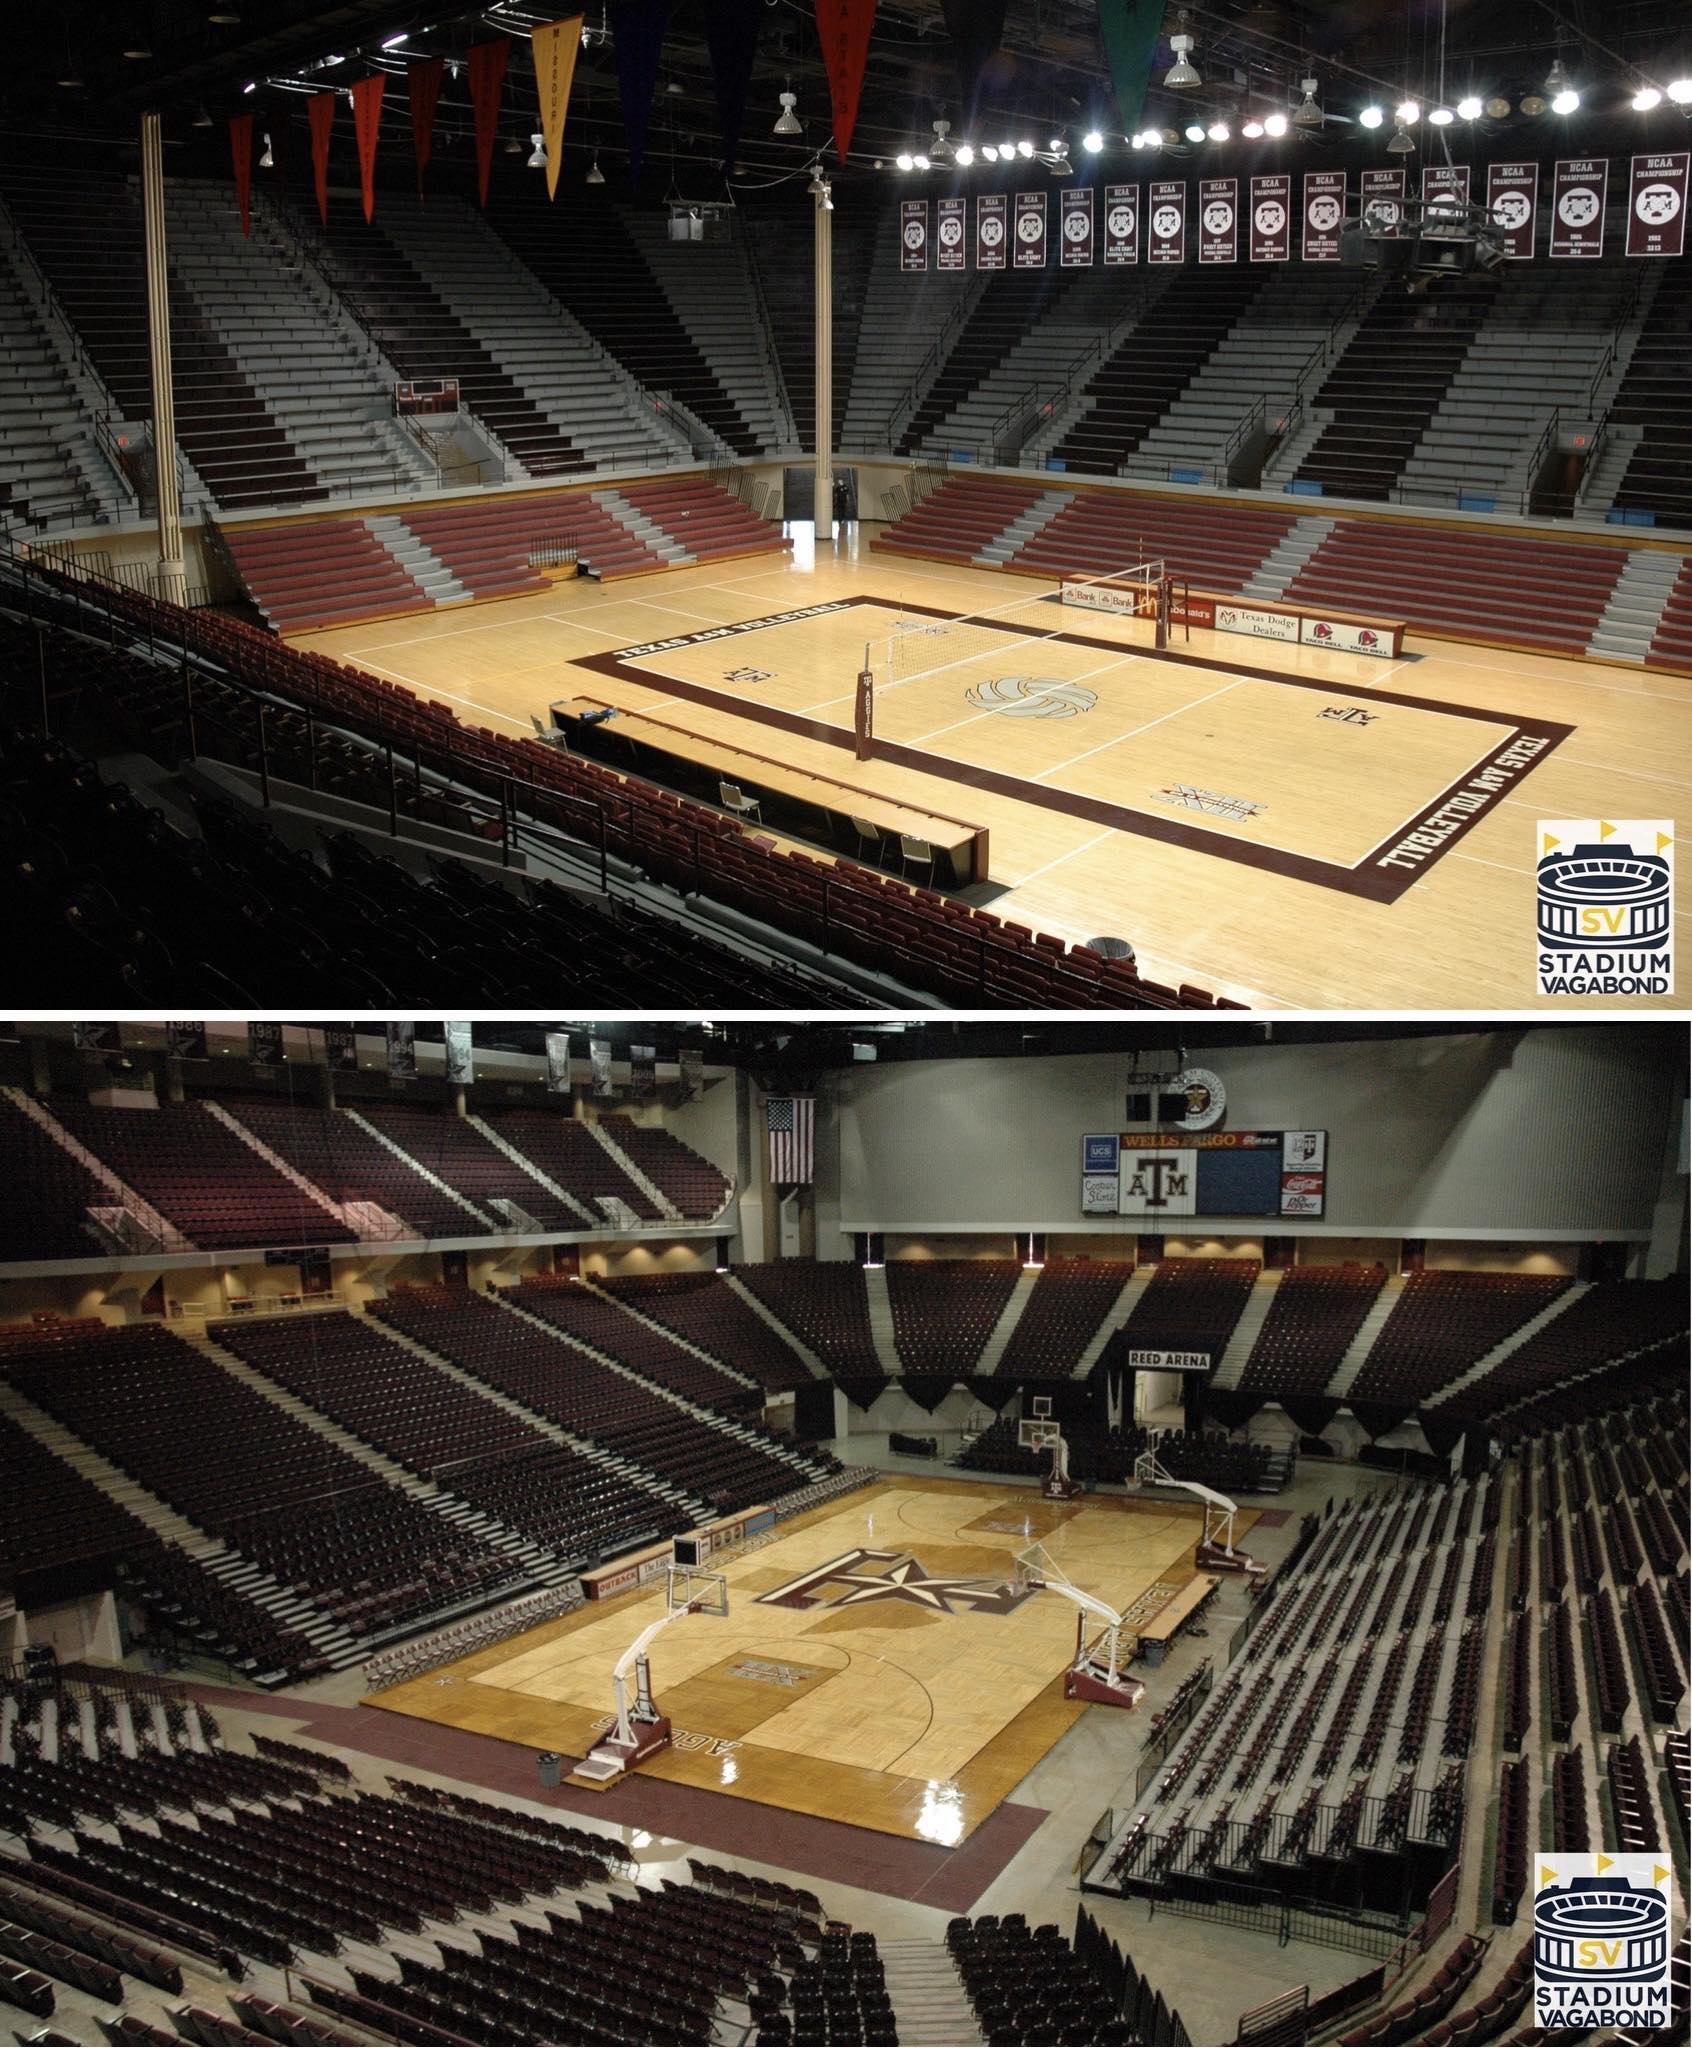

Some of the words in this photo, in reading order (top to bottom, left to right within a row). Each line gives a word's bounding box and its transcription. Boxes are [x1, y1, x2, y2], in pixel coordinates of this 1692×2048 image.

[1569, 163, 1594, 172] NCAA
[1647, 157, 1673, 168] NCAA
[1501, 166, 1524, 176] NCAA
[1636, 169, 1683, 178] CHAMPIONSHIP
[1315, 176, 1334, 184] NCAA
[1373, 173, 1393, 182] NCAA
[1559, 173, 1602, 181] CHAMPIONSHIP
[1077, 591, 1096, 601] Bank
[1113, 596, 1133, 607] Bank
[1240, 611, 1266, 626] Texas
[1268, 615, 1296, 628] Dodge
[612, 638, 690, 659] TEXAS
[731, 602, 851, 631] VOLLEYBALL
[1252, 624, 1285, 638] Dealers
[1305, 637, 1324, 646] TACO
[1350, 645, 1369, 653] TACO
[1493, 735, 1551, 769] TEXAS
[1468, 766, 1514, 792] A&M
[1376, 790, 1491, 870] VOLLEYBALL
[1125, 1135, 1180, 1147] WELLS
[1091, 1146, 1111, 1156] UCS
[1131, 1353, 1161, 1364] REED
[1166, 1354, 1207, 1367] ARENA
[600, 1570, 637, 1592] OUTBACK
